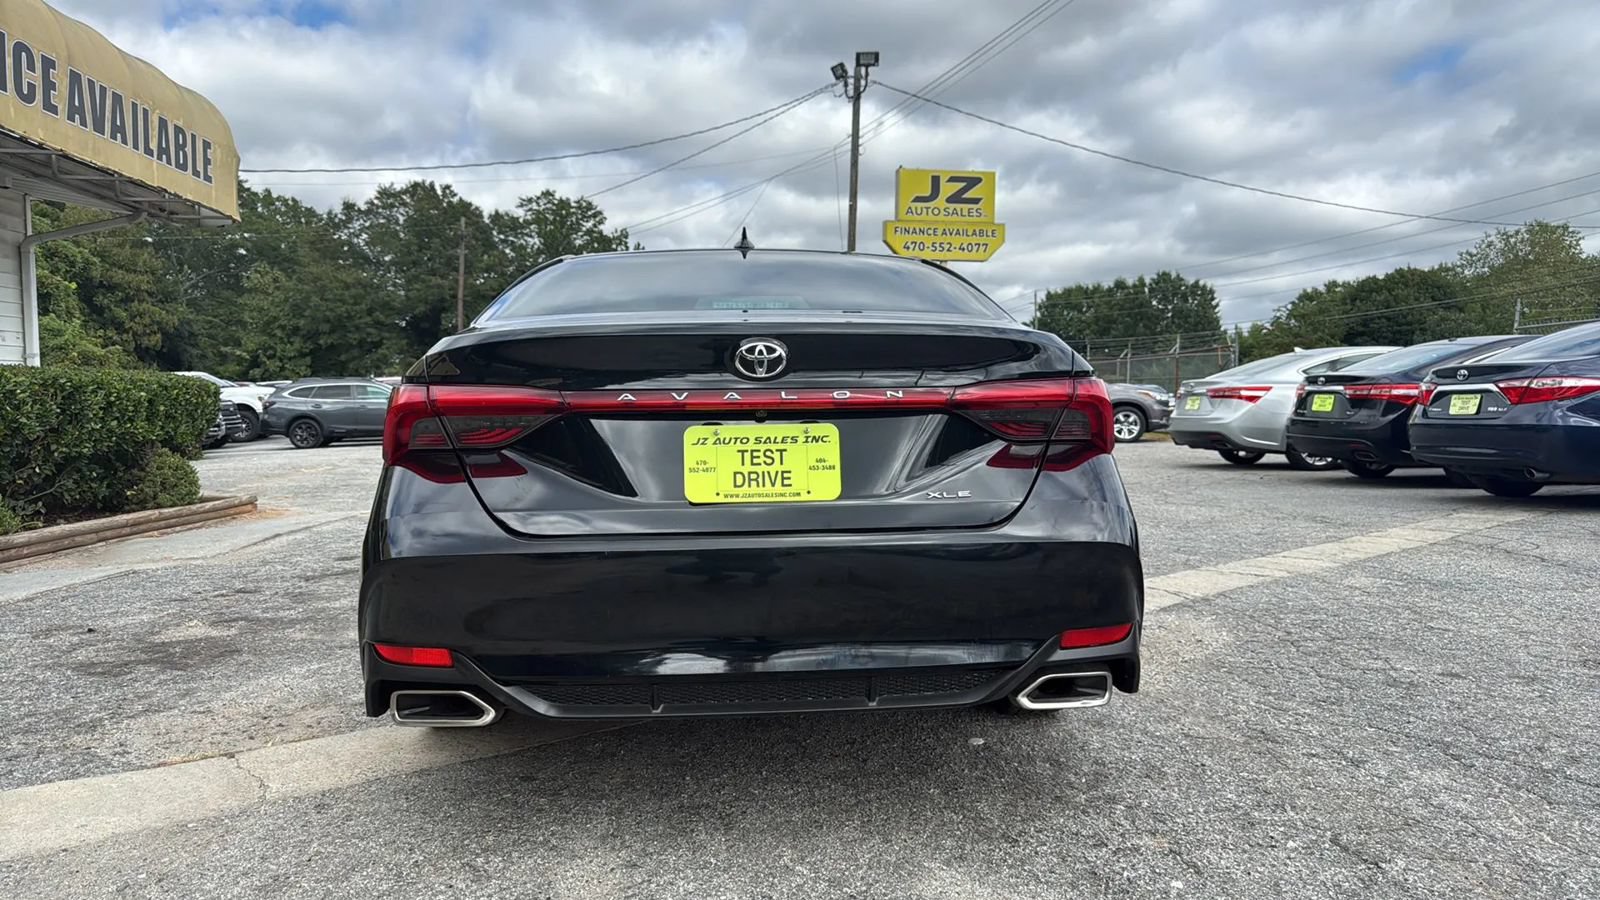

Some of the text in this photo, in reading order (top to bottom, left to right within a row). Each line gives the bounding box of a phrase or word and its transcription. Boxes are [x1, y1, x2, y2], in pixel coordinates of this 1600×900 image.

[65, 66, 214, 186] AVAILABLE
[910, 175, 984, 205] JZ
[905, 206, 941, 216] AUTO
[943, 207, 983, 218] SALES
[894, 226, 997, 238] FINANCE AVAILABLE
[903, 241, 989, 253] 470-552-4077
[617, 390, 904, 401] AVALON
[691, 435, 831, 446] JZ AUTO SALES INC.
[737, 448, 787, 467] TEST
[733, 470, 793, 489] DRIVE
[927, 490, 972, 499] XLE
